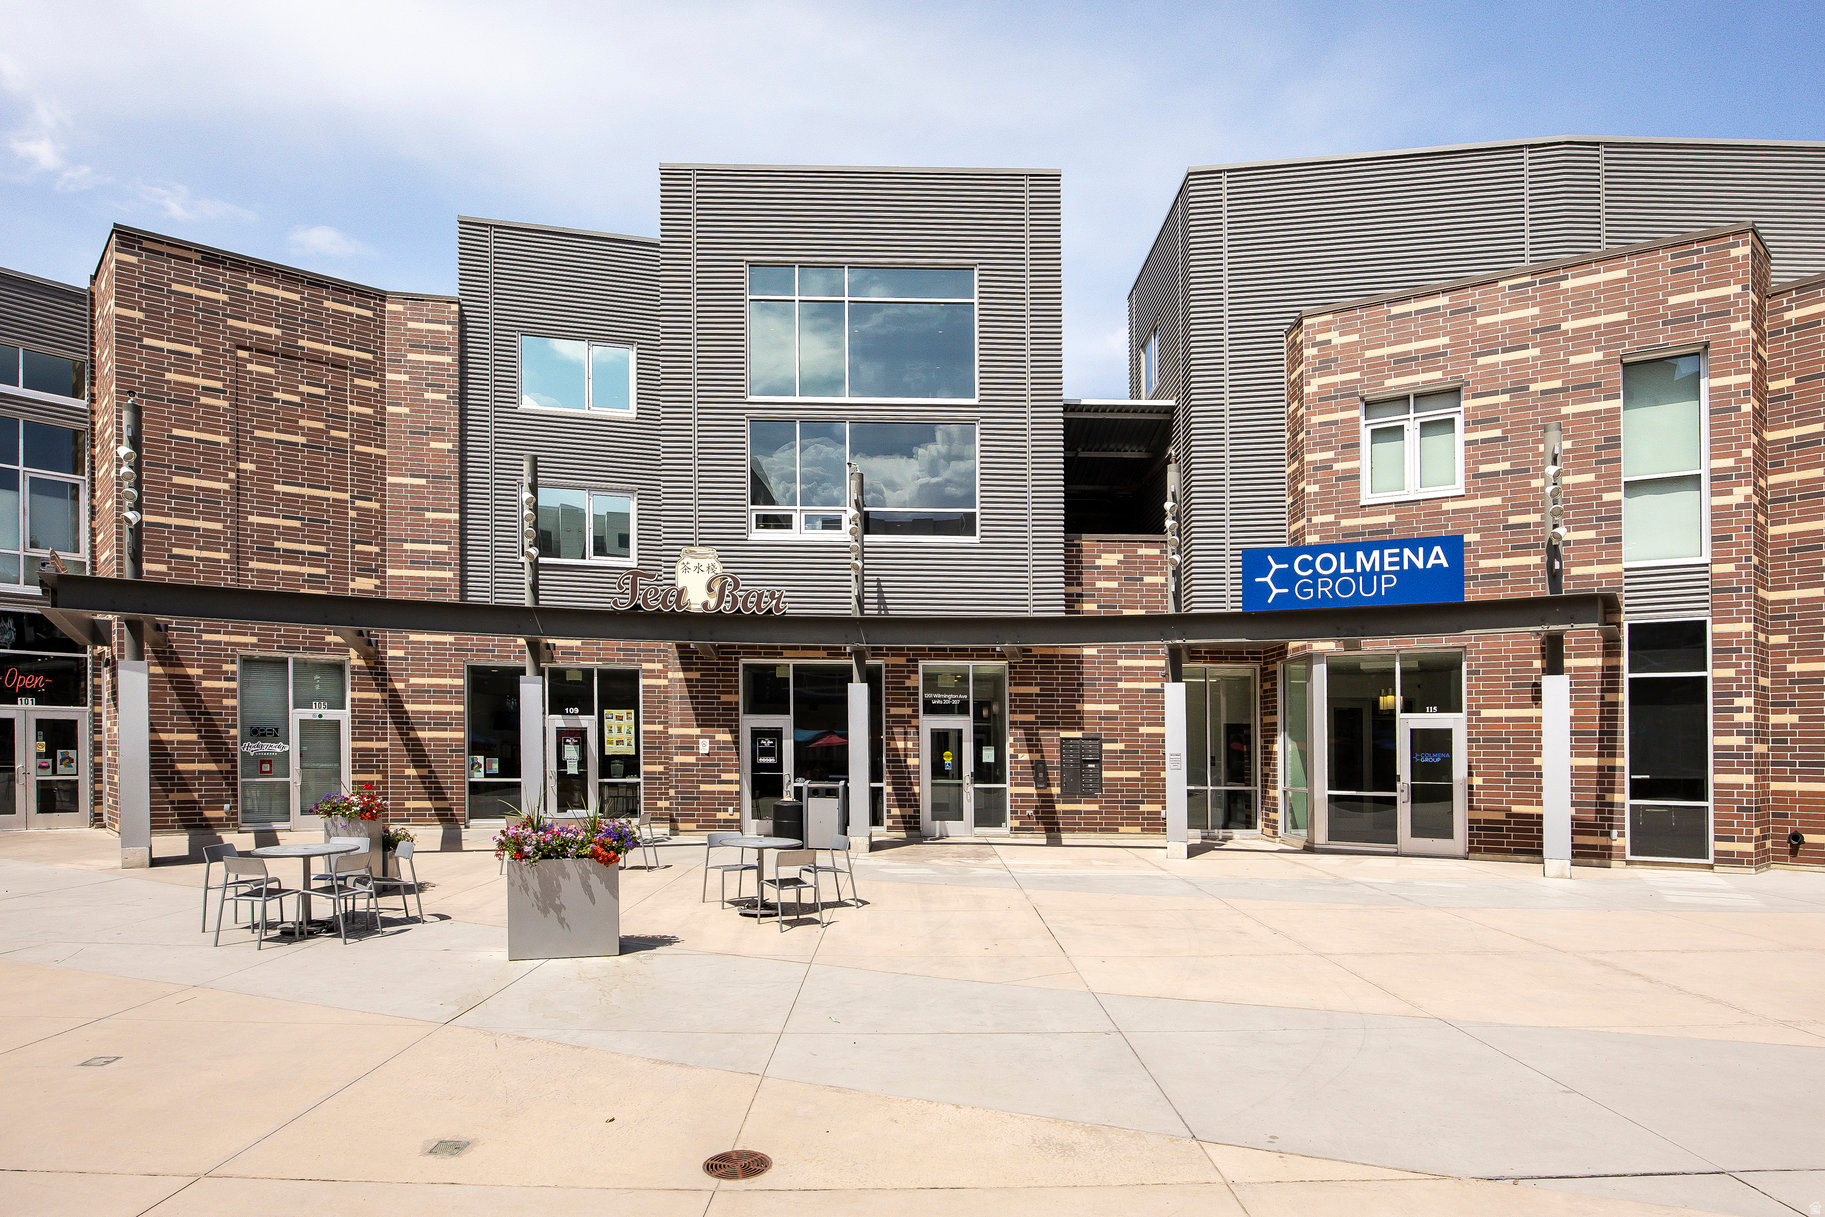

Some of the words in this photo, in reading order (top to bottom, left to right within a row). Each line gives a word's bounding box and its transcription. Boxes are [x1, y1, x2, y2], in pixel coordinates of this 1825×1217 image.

[1293, 545, 1450, 577] COLMENA
[610, 568, 691, 613] Tea
[701, 572, 789, 616] Bar
[1294, 573, 1398, 601] GROUP
[4, 667, 45, 693] Open
[18, 698, 35, 706] 101
[250, 727, 280, 738] OPEN
